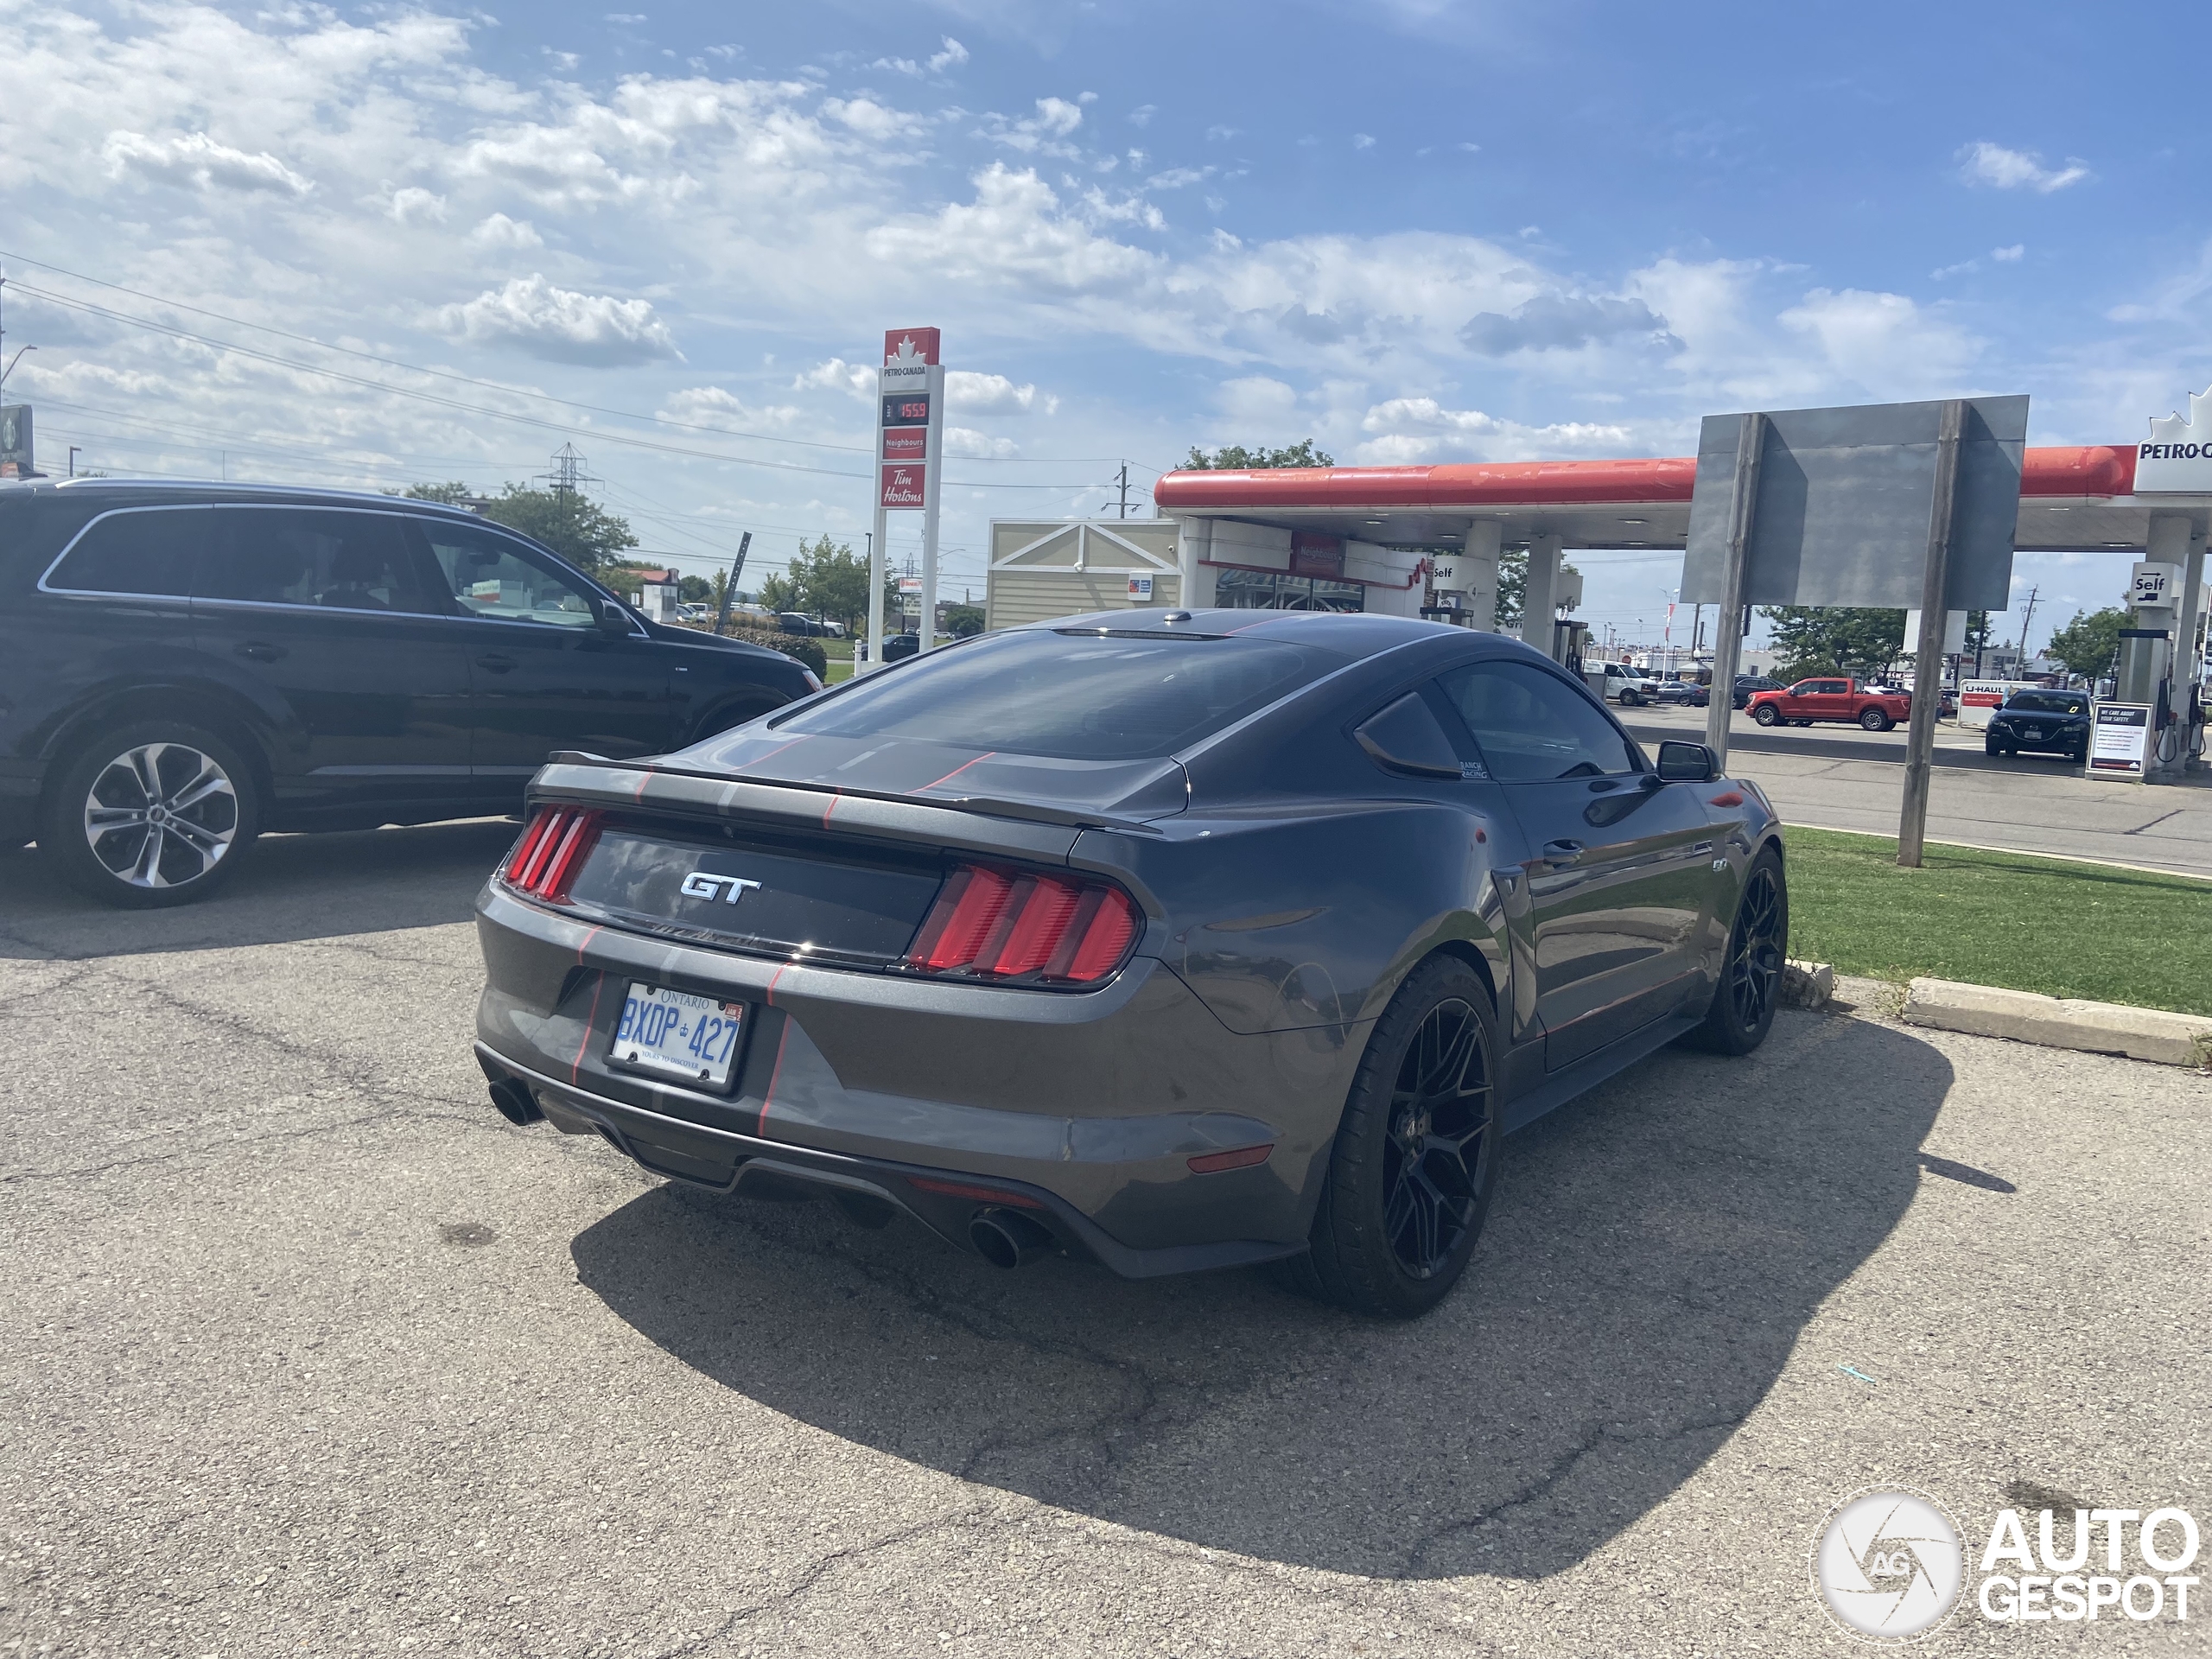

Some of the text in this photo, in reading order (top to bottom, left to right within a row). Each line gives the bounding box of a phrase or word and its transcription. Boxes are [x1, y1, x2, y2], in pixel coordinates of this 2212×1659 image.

[886, 439, 924, 448] Neighbours
[893, 469, 912, 486] Tim
[884, 486, 922, 502] Hortons
[1300, 545, 1338, 560] Neighbours
[1433, 567, 1452, 577] Self
[2135, 577, 2165, 591] Self
[1471, 587, 1477, 597] 4
[1460, 761, 1483, 772] RANCH
[680, 871, 763, 905] GT
[661, 989, 709, 1011] ONTARIO
[688, 1014, 739, 1064] 427
[641, 1050, 699, 1070] YOURS TO DISCOVER
